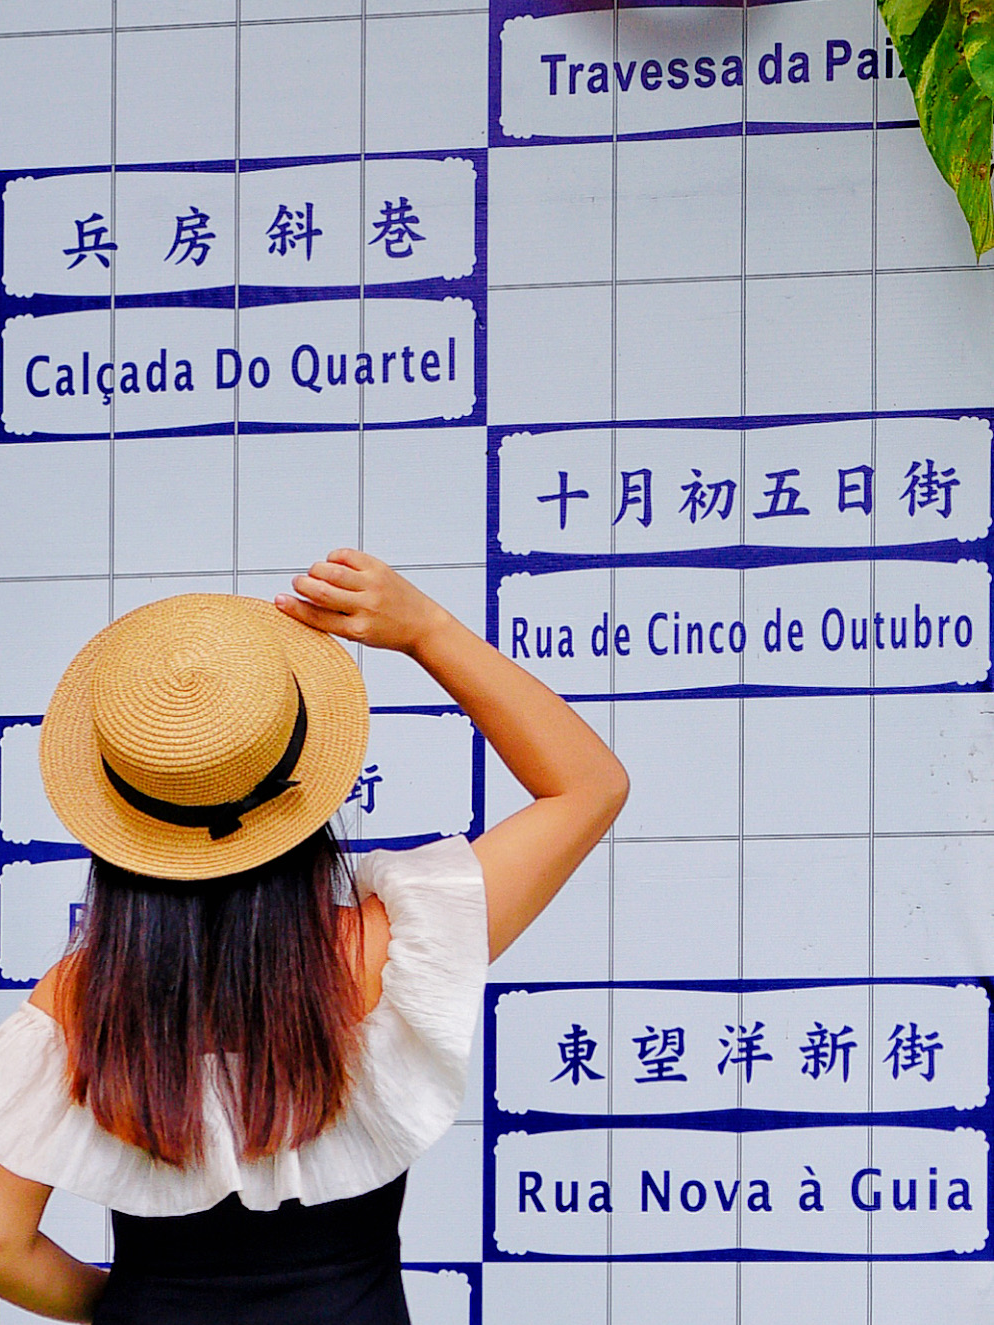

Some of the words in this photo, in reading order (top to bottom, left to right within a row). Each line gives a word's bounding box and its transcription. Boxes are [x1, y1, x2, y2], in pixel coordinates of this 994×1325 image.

[540, 52, 744, 96] Travessa
[758, 42, 810, 85] da
[825, 36, 907, 82] Pai
[62, 196, 427, 270] 兵房斜巷
[25, 348, 195, 407] Calçada
[216, 347, 271, 390] Do
[291, 336, 457, 394] Quartel
[536, 457, 962, 532] 十月初五日街
[511, 616, 575, 659] Rua
[591, 611, 631, 657] de
[647, 611, 747, 656] Cinco
[763, 607, 804, 653] de
[821, 603, 973, 652] Outubro
[549, 1020, 945, 1086] 東望洋新街
[518, 1170, 614, 1214] Rua
[641, 1169, 773, 1213] Nova
[798, 1164, 825, 1213] à
[850, 1165, 974, 1213] Guia
